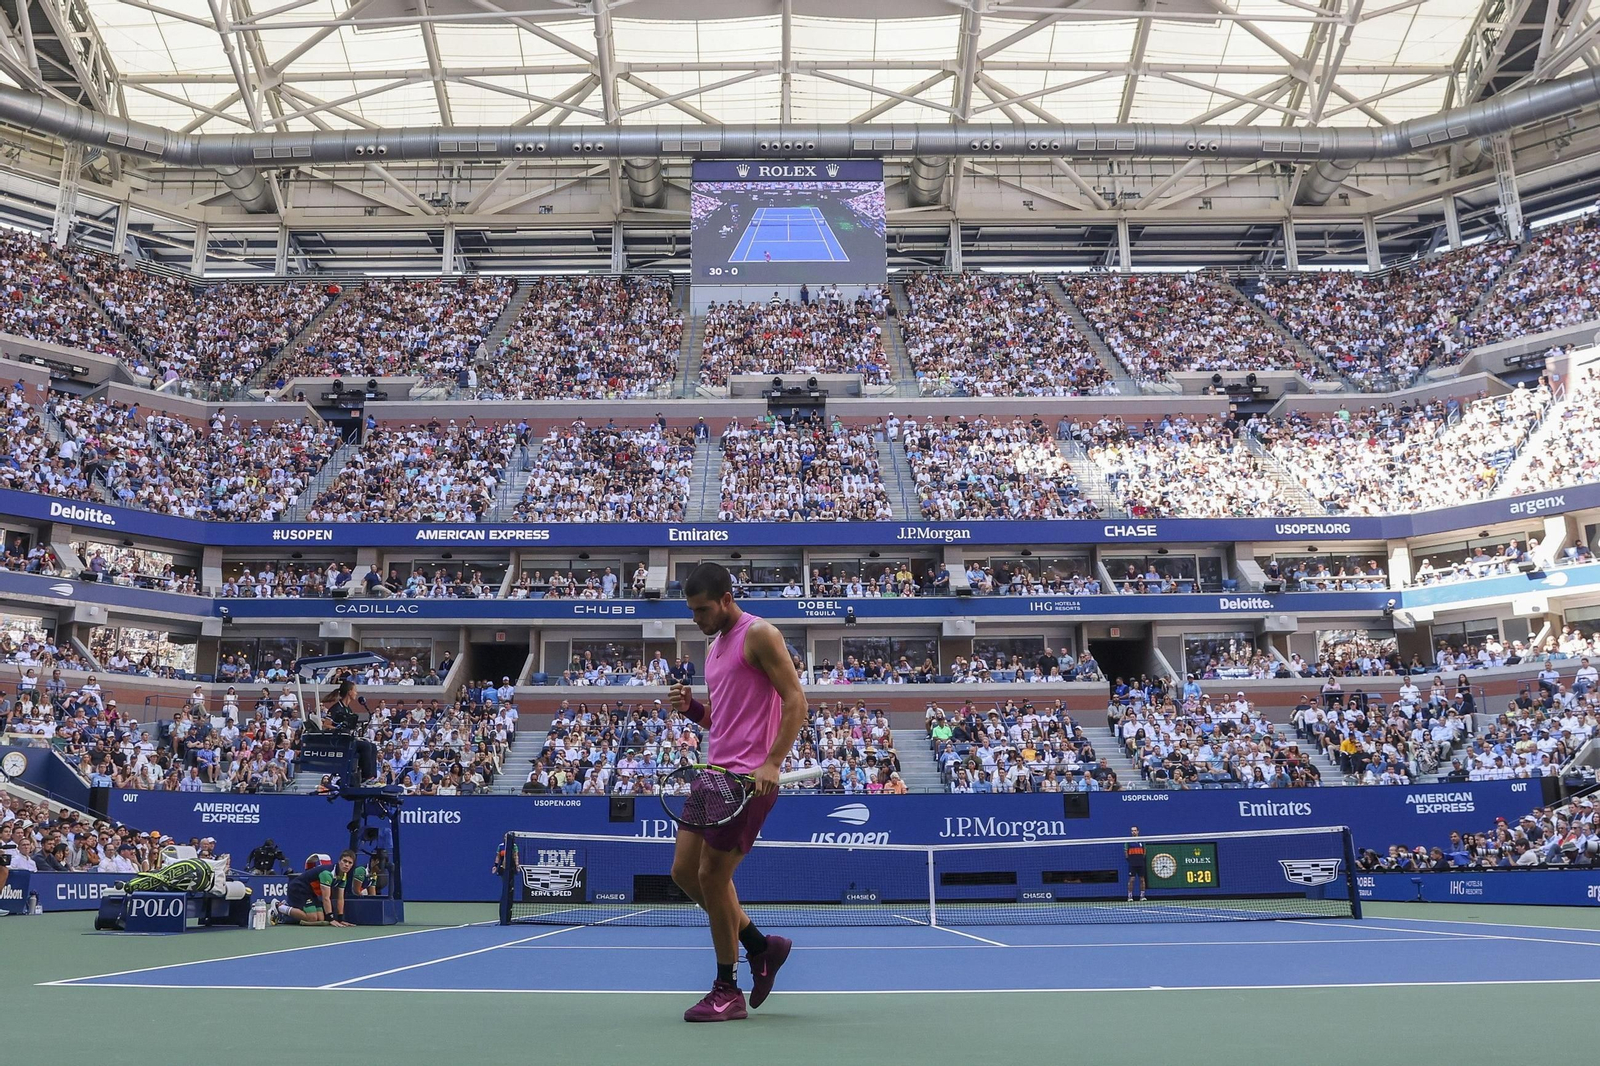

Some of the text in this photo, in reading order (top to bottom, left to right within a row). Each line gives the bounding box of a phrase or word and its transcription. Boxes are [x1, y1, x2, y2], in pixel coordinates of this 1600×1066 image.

[758, 166, 818, 177] ROLEX
[709, 267, 722, 275] 30
[731, 267, 739, 275] 0
[1509, 494, 1566, 515] argenx
[50, 502, 116, 526] Deloitte.
[272, 529, 333, 541] #USOPEN
[415, 529, 550, 540] AMERICAN EXPRESS
[668, 528, 729, 541] Emirates
[896, 527, 971, 543] J.P.Morgan
[1104, 525, 1157, 537] CHASE
[1275, 523, 1351, 535] USOPEN.ORG
[335, 604, 419, 614] CADILLAC
[574, 605, 636, 614] CHUBB
[798, 601, 842, 610] DOBEL
[1030, 601, 1053, 611] IHG
[1219, 598, 1274, 610] Deloitte.
[303, 750, 344, 758] CHUBB
[1511, 783, 1528, 793] OUT
[122, 793, 139, 803] OUT
[1122, 794, 1169, 802] USOPEN.ORG
[1405, 791, 1473, 804] AMERICAN
[193, 802, 260, 813] AMERICAN
[1238, 800, 1312, 817] Emirates
[1416, 802, 1475, 814] EXPRESS
[201, 813, 260, 824] EXPRESS
[400, 807, 462, 824] mirates
[938, 816, 1067, 841] J.P.Morgan
[538, 850, 576, 867] IBM
[1186, 870, 1212, 883] 0:20
[1450, 880, 1465, 895] IHG
[130, 899, 184, 918] POLO
